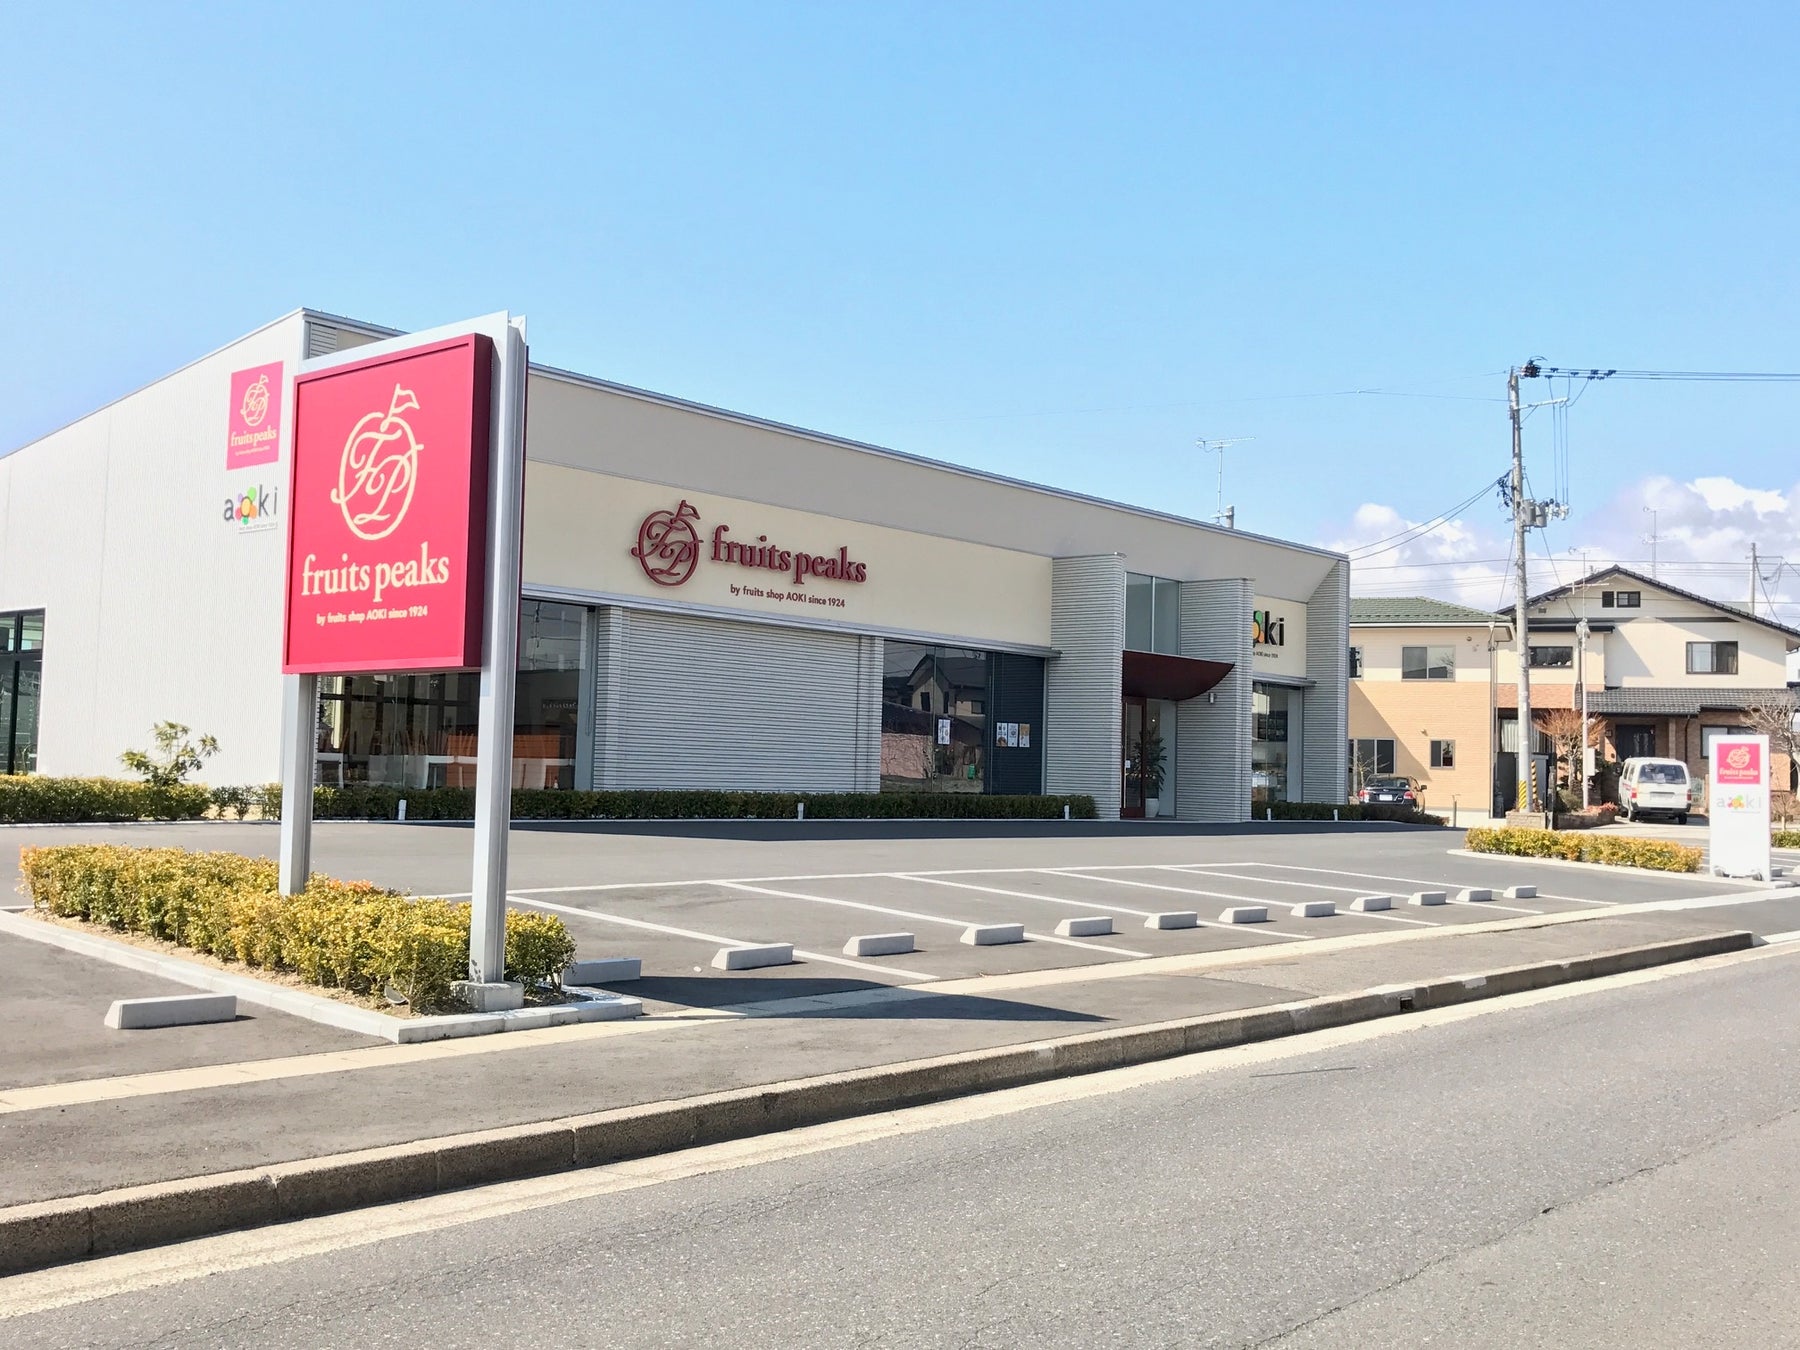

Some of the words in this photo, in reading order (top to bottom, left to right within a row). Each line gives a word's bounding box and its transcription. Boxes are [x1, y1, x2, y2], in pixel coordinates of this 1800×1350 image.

[231, 431, 252, 446] fruits
[253, 424, 277, 447] peaks
[224, 484, 278, 522] aoki
[711, 525, 791, 571] fruits
[793, 546, 866, 585] peaks
[301, 552, 370, 596] fruits
[372, 541, 449, 603] peaks
[730, 584, 740, 596] by
[743, 586, 764, 596] fruits
[766, 589, 784, 602] shop
[786, 592, 807, 603] AOKI
[808, 595, 826, 605] since
[828, 597, 845, 608] 1924
[316, 613, 326, 626] by
[327, 612, 347, 624] fruits
[348, 611, 365, 624] shop
[366, 608, 387, 620] AOKI
[388, 607, 407, 619] since
[408, 605, 428, 617] 1924
